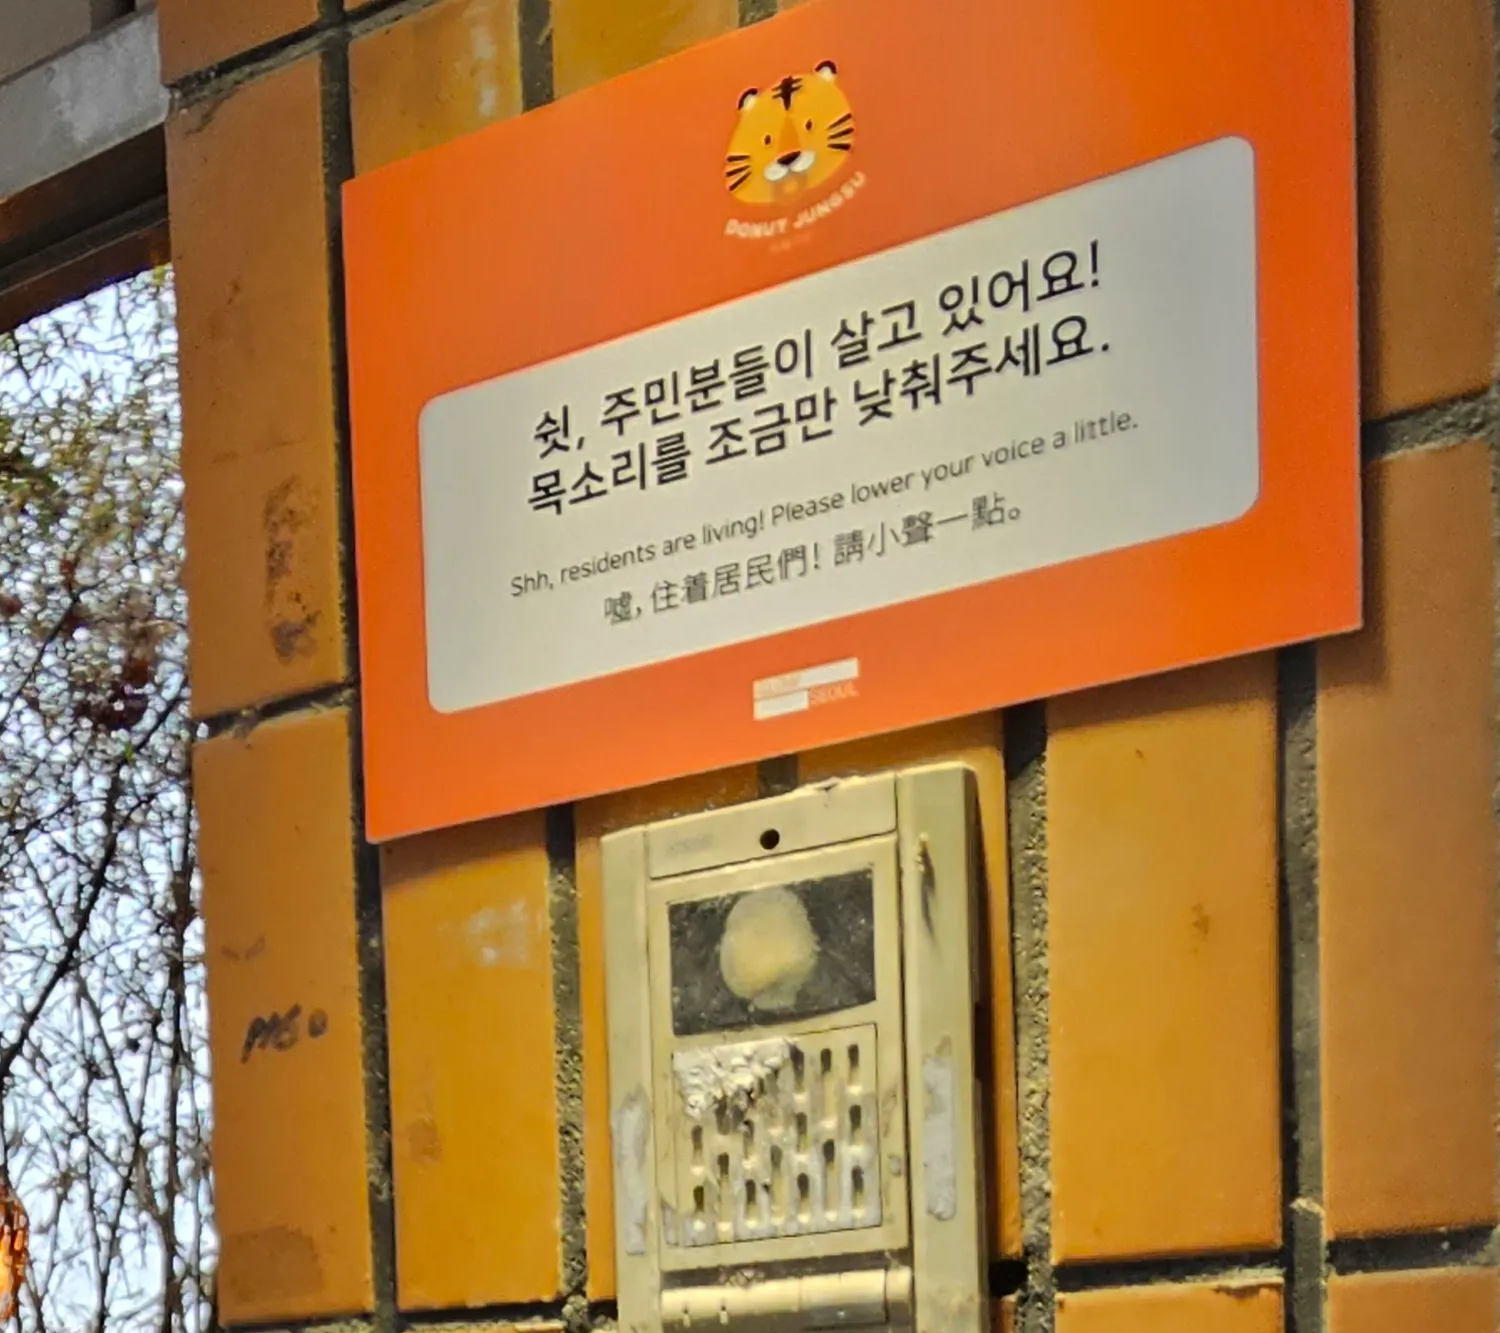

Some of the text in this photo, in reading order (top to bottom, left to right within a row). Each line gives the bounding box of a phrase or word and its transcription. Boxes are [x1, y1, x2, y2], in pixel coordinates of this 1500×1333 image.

[724, 217, 788, 239] DONUT
[527, 314, 1110, 516] 목소리를 조금만 낮춰주세요.
[534, 238, 1100, 459] 쉿, 주민분들이 살고 있어요!
[510, 409, 1139, 597] Shh, residents are living! Please lower your voice a little.
